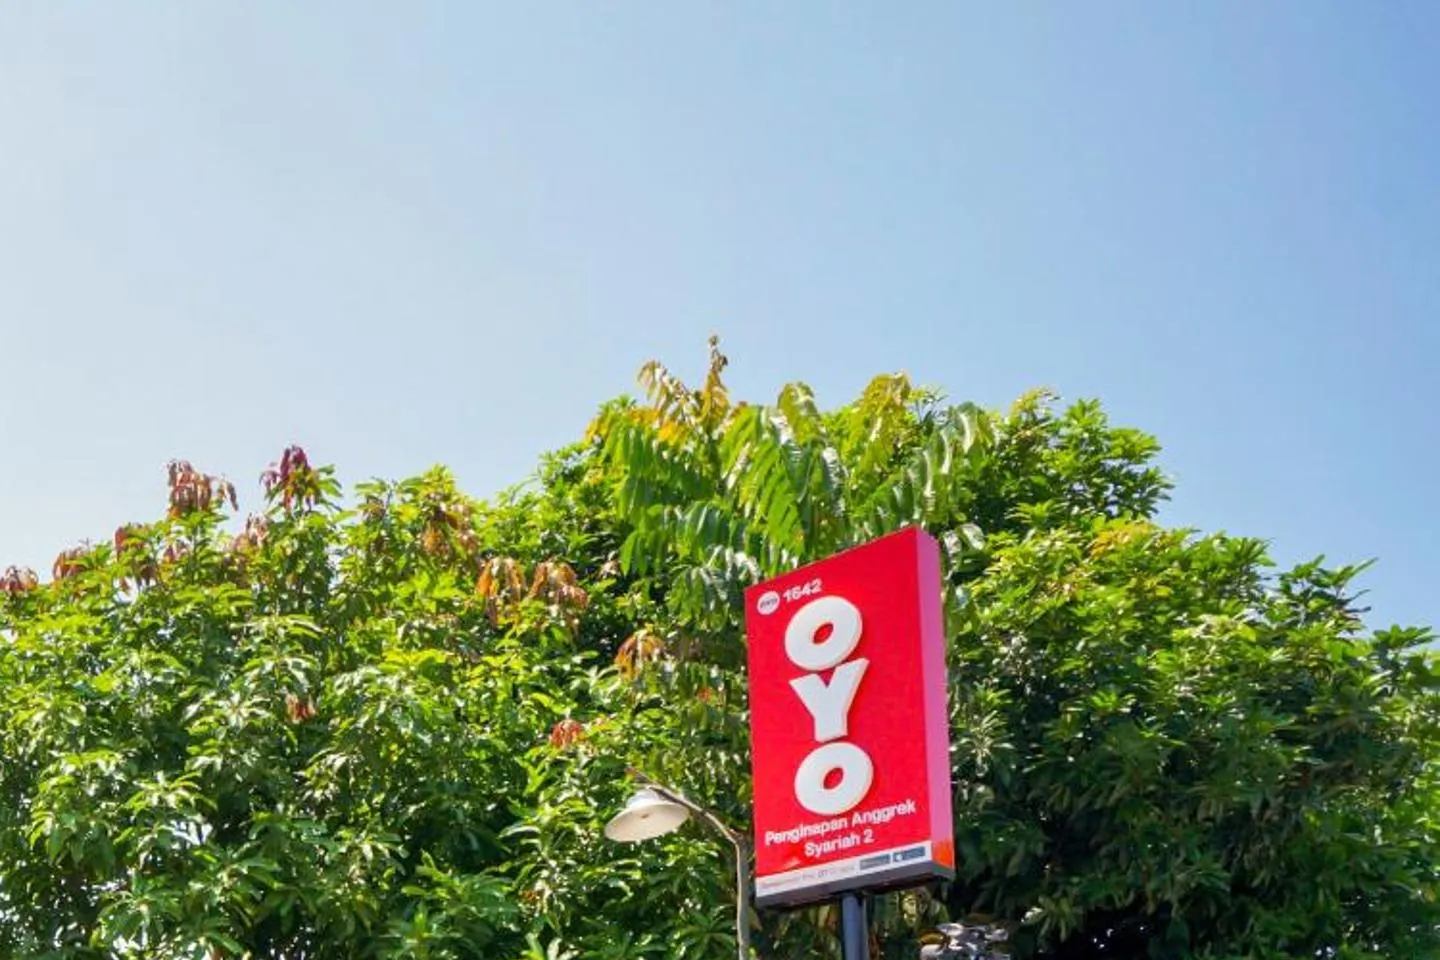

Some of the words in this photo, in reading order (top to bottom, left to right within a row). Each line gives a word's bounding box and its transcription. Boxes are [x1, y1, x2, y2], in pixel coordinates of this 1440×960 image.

[784, 595, 874, 815] OYO
[765, 816, 848, 845] Penginapan
[852, 799, 916, 826] Anggrek
[804, 832, 860, 857] Syariah
[863, 828, 875, 844] 2
